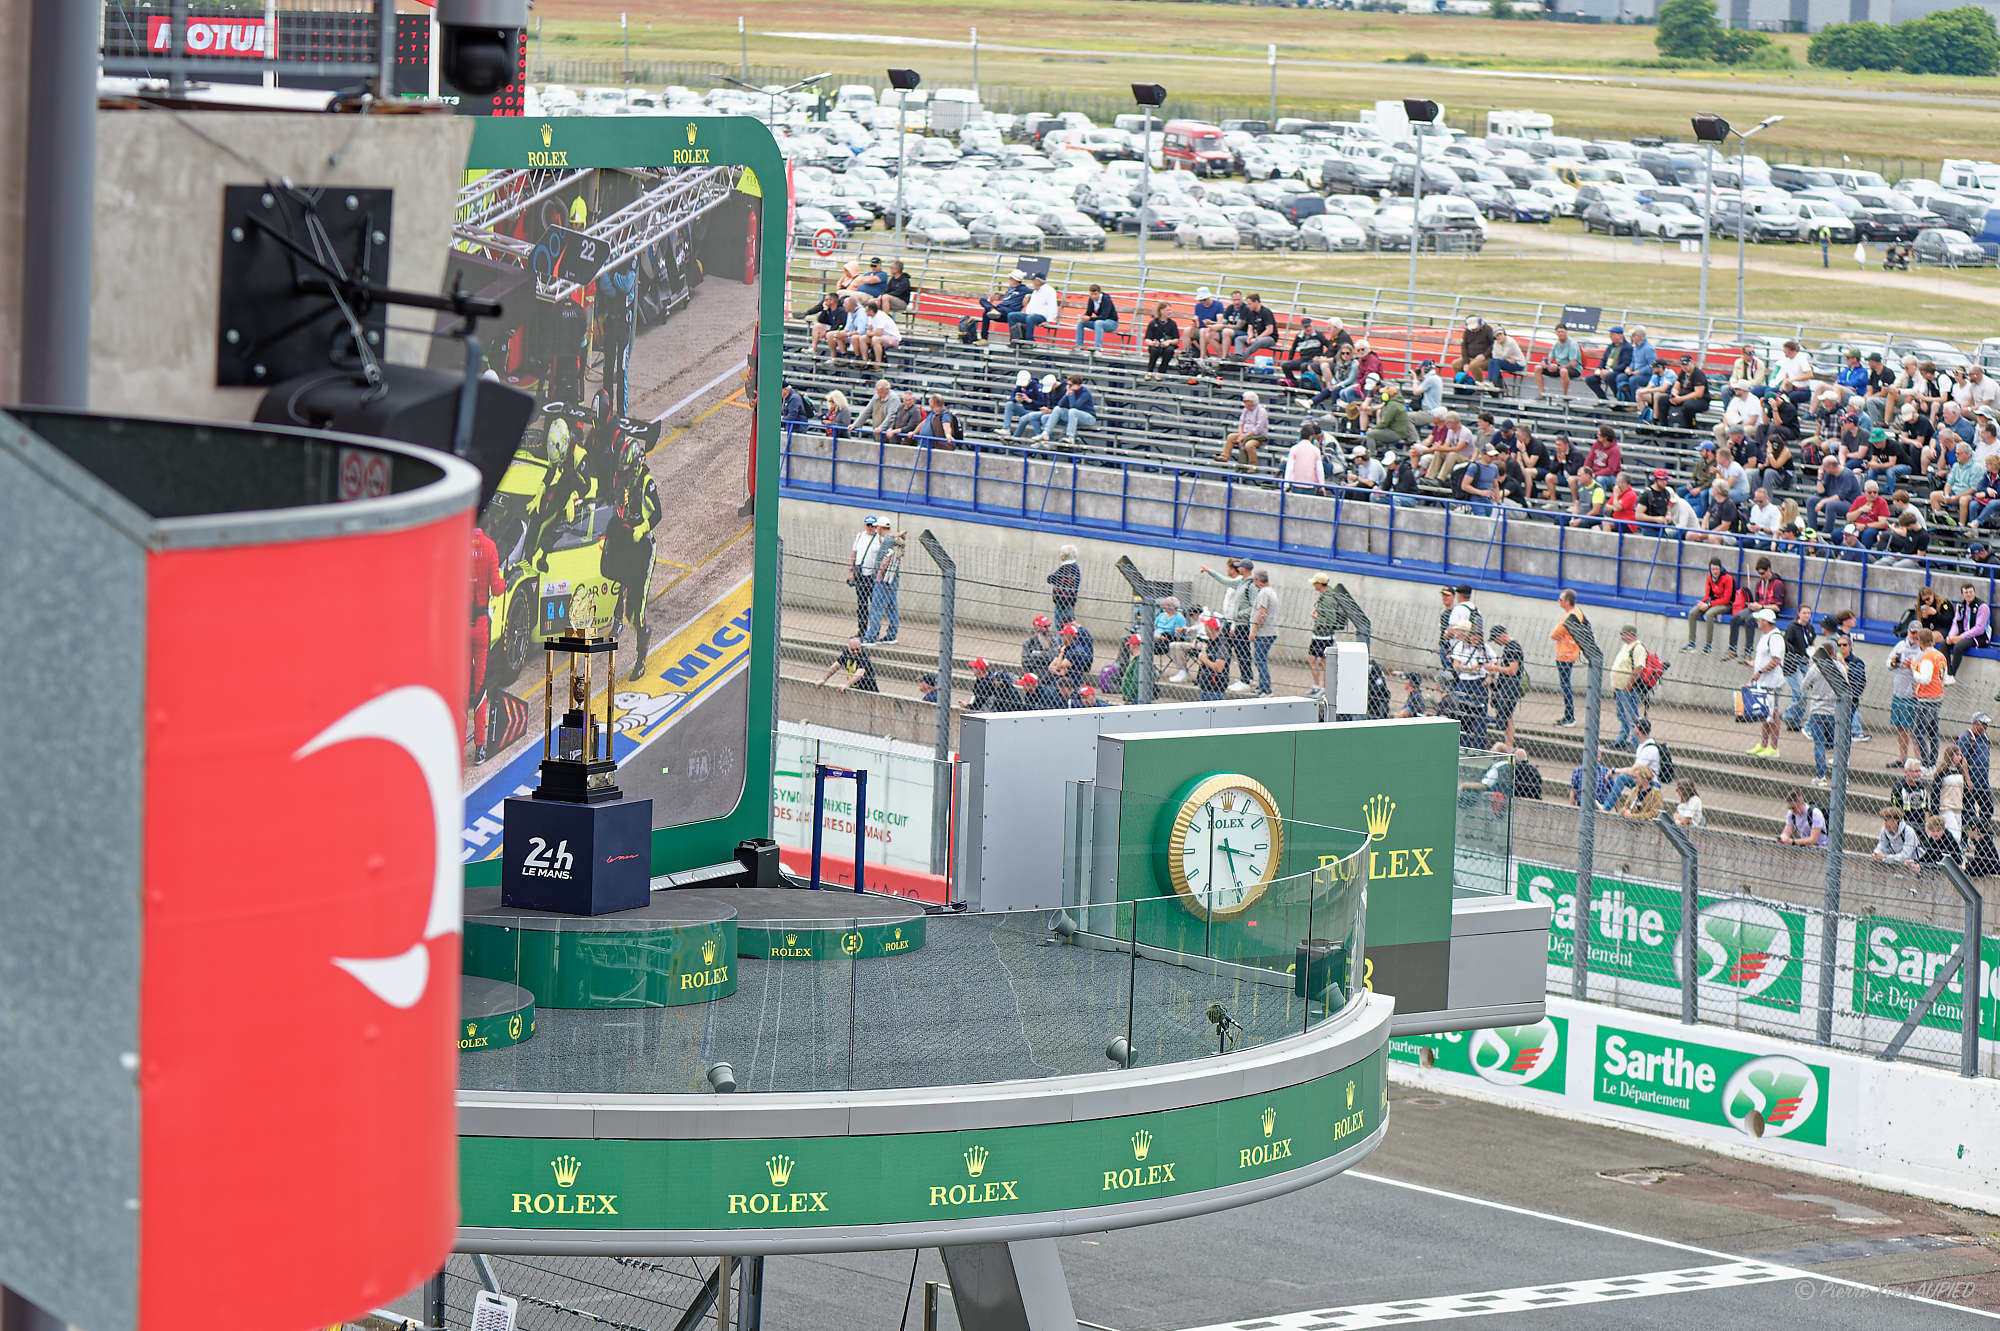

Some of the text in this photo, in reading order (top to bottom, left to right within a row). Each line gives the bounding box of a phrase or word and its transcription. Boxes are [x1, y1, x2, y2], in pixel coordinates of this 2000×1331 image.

[528, 152, 568, 167] ROLEX
[673, 149, 710, 164] ROLEX
[579, 239, 596, 262] 22
[1207, 818, 1245, 830] ROLEX
[522, 866, 537, 877] LE
[771, 947, 812, 957] ROLEX
[885, 939, 909, 952] ROLEX
[680, 966, 729, 990] ROLEX
[1866, 981, 1884, 1003] Le
[1604, 1035, 1716, 1093] Sarthe
[1603, 1077, 1690, 1110] Le Département
[1333, 1109, 1364, 1141] ROLEX
[1239, 1138, 1292, 1169] ROLEX
[1102, 1162, 1177, 1191] ROLEX
[511, 1193, 619, 1215] ROLEX
[727, 1191, 829, 1215] ROLEX
[929, 1181, 1019, 1206] ROLEX
